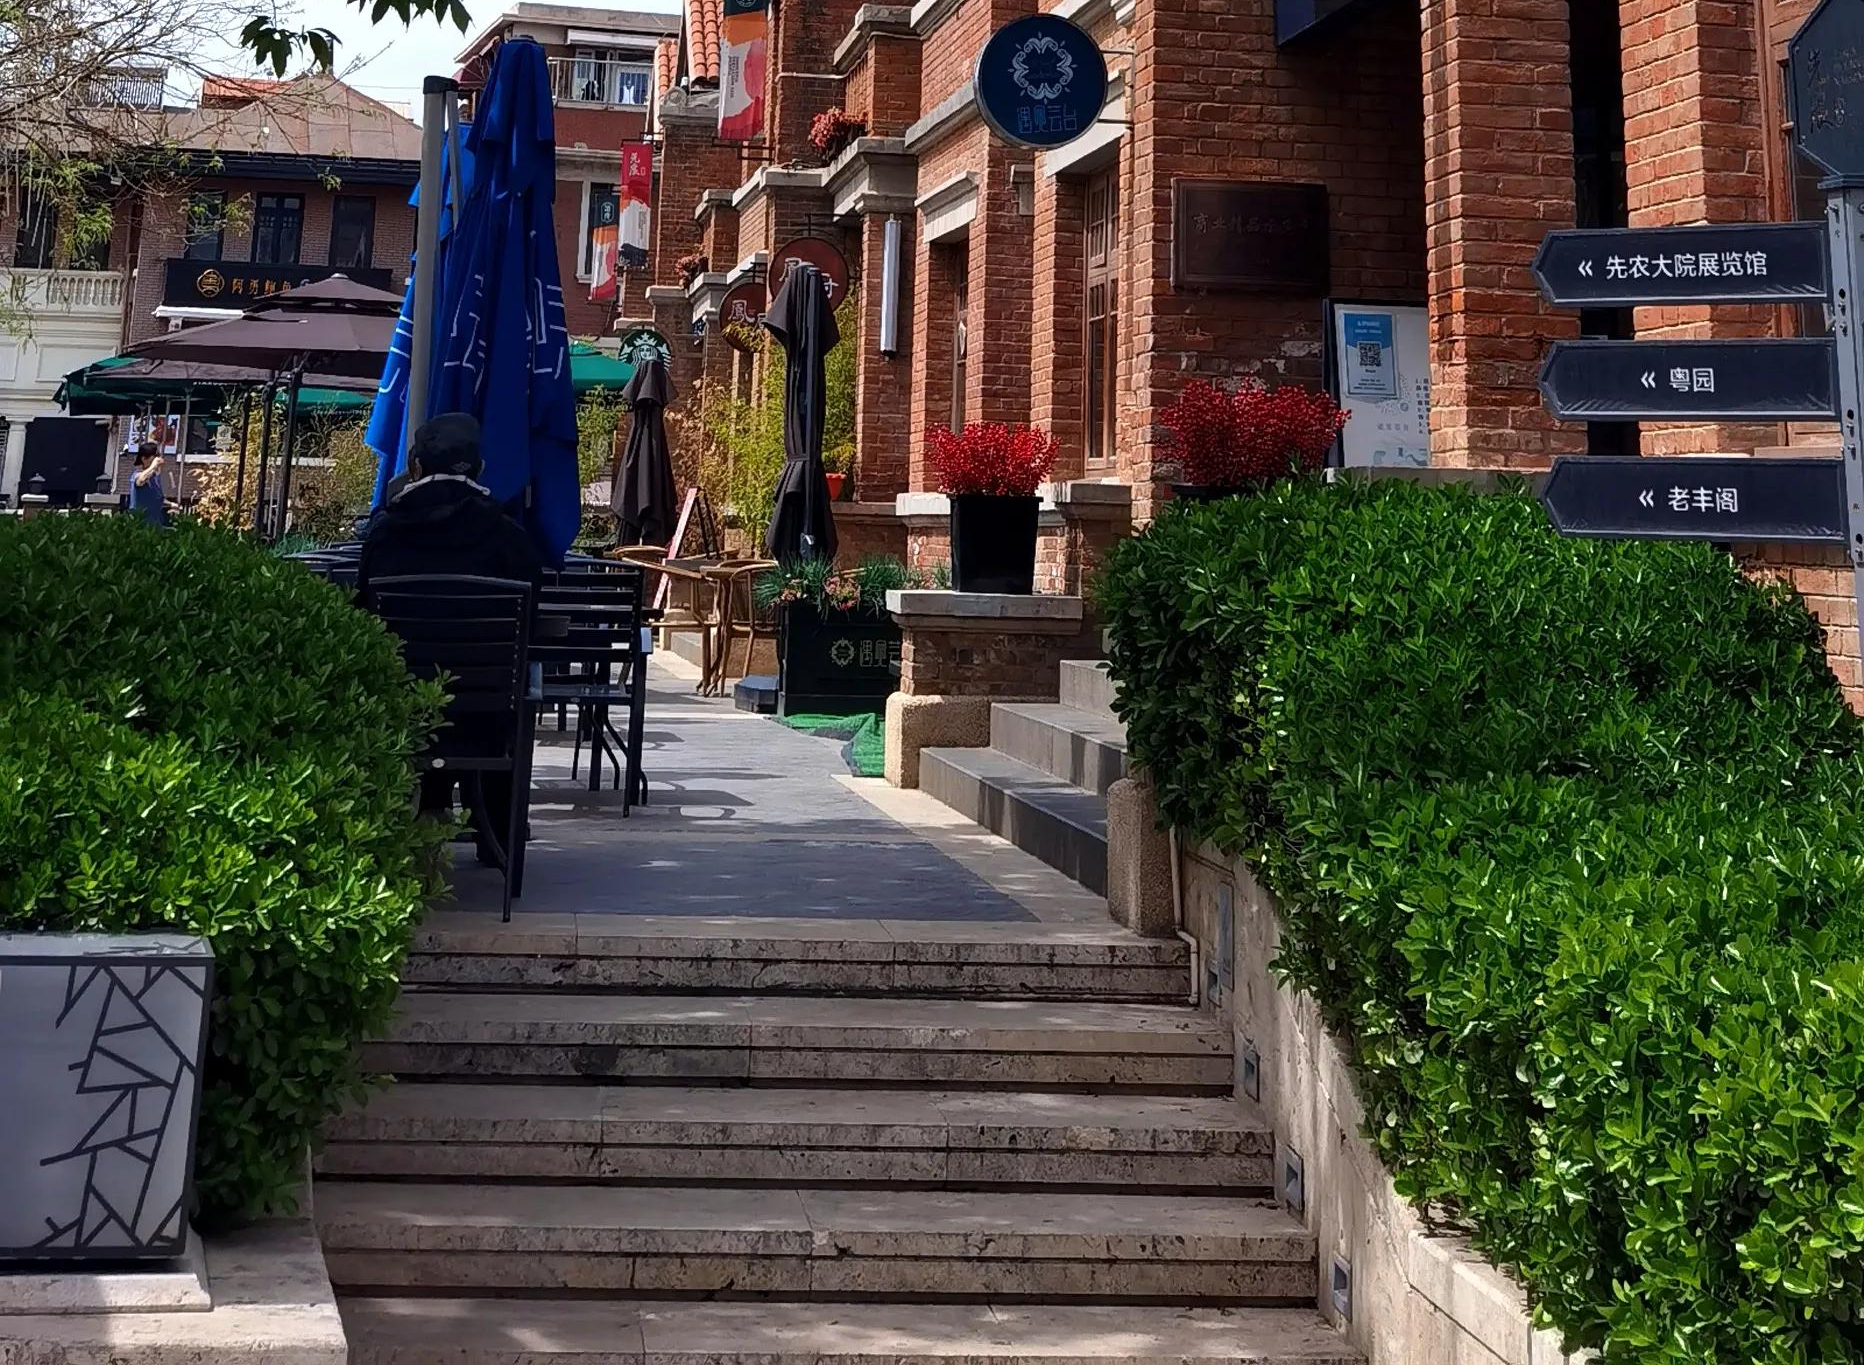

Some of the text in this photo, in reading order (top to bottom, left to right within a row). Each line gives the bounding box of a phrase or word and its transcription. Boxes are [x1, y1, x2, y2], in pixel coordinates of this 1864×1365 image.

[1605, 251, 1768, 280] 先农大院展览馆
[1668, 366, 1715, 394] 粤园
[1667, 485, 1739, 514] 老丰阁
